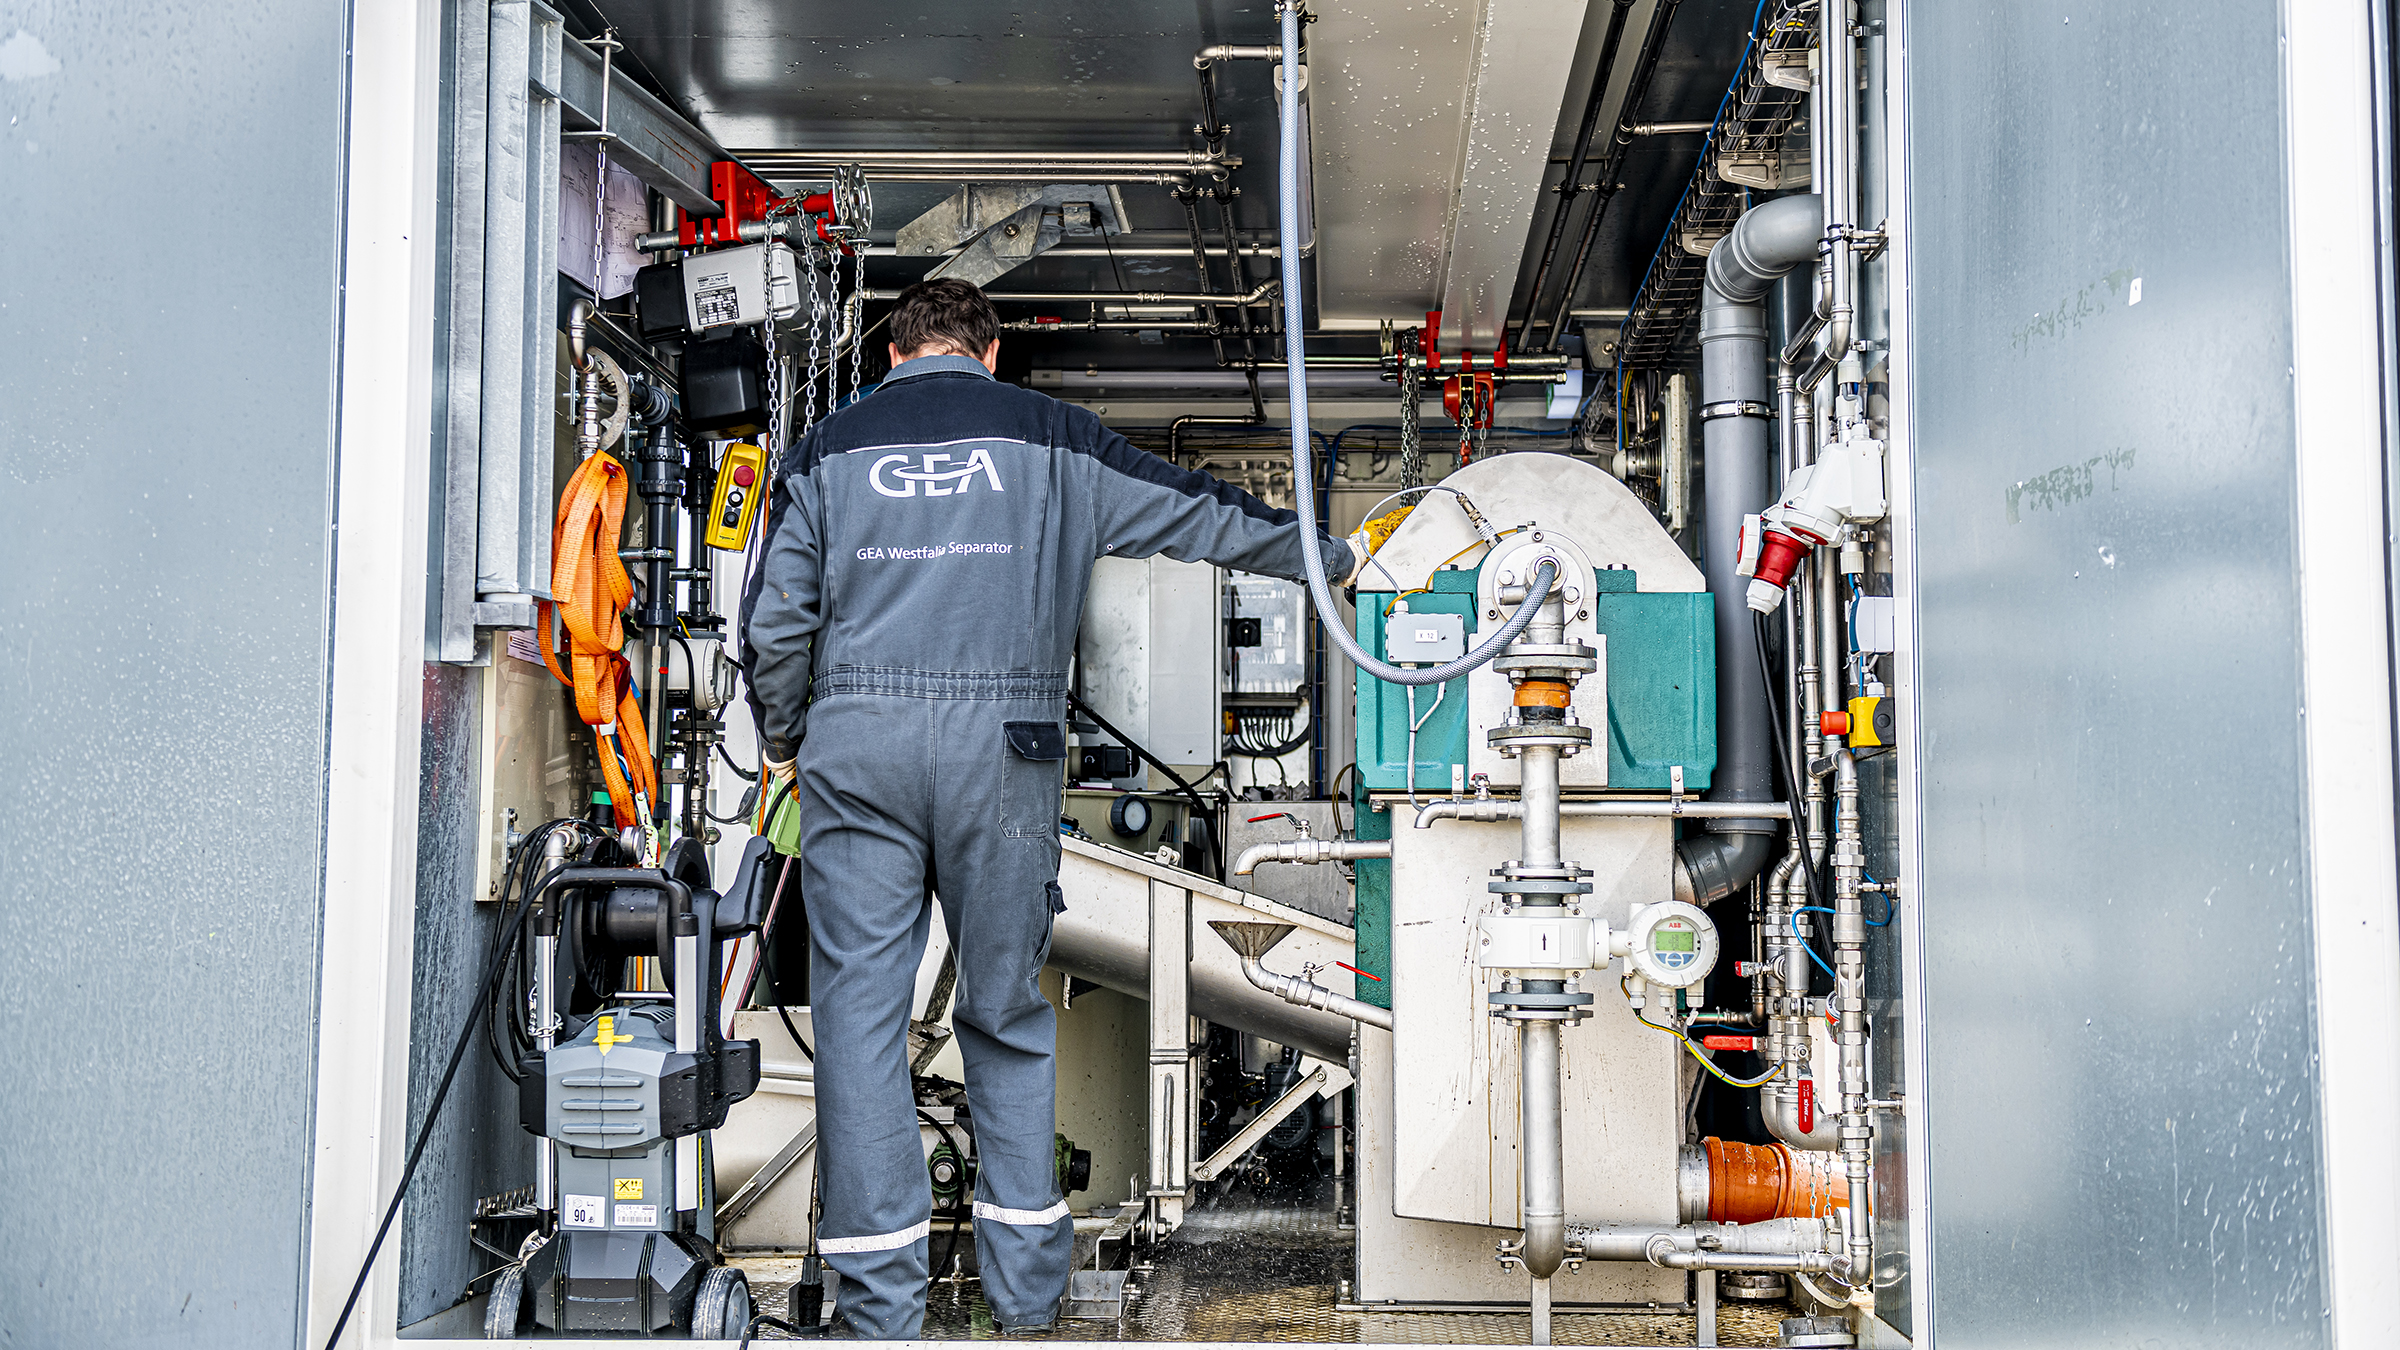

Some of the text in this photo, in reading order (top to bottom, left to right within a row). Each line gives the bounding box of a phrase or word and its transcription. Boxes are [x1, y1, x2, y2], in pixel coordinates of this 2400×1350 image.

[868, 449, 1005, 498] GEA
[856, 541, 1013, 560] GEA Westfalia Separator
[574, 1208, 586, 1223] 90
